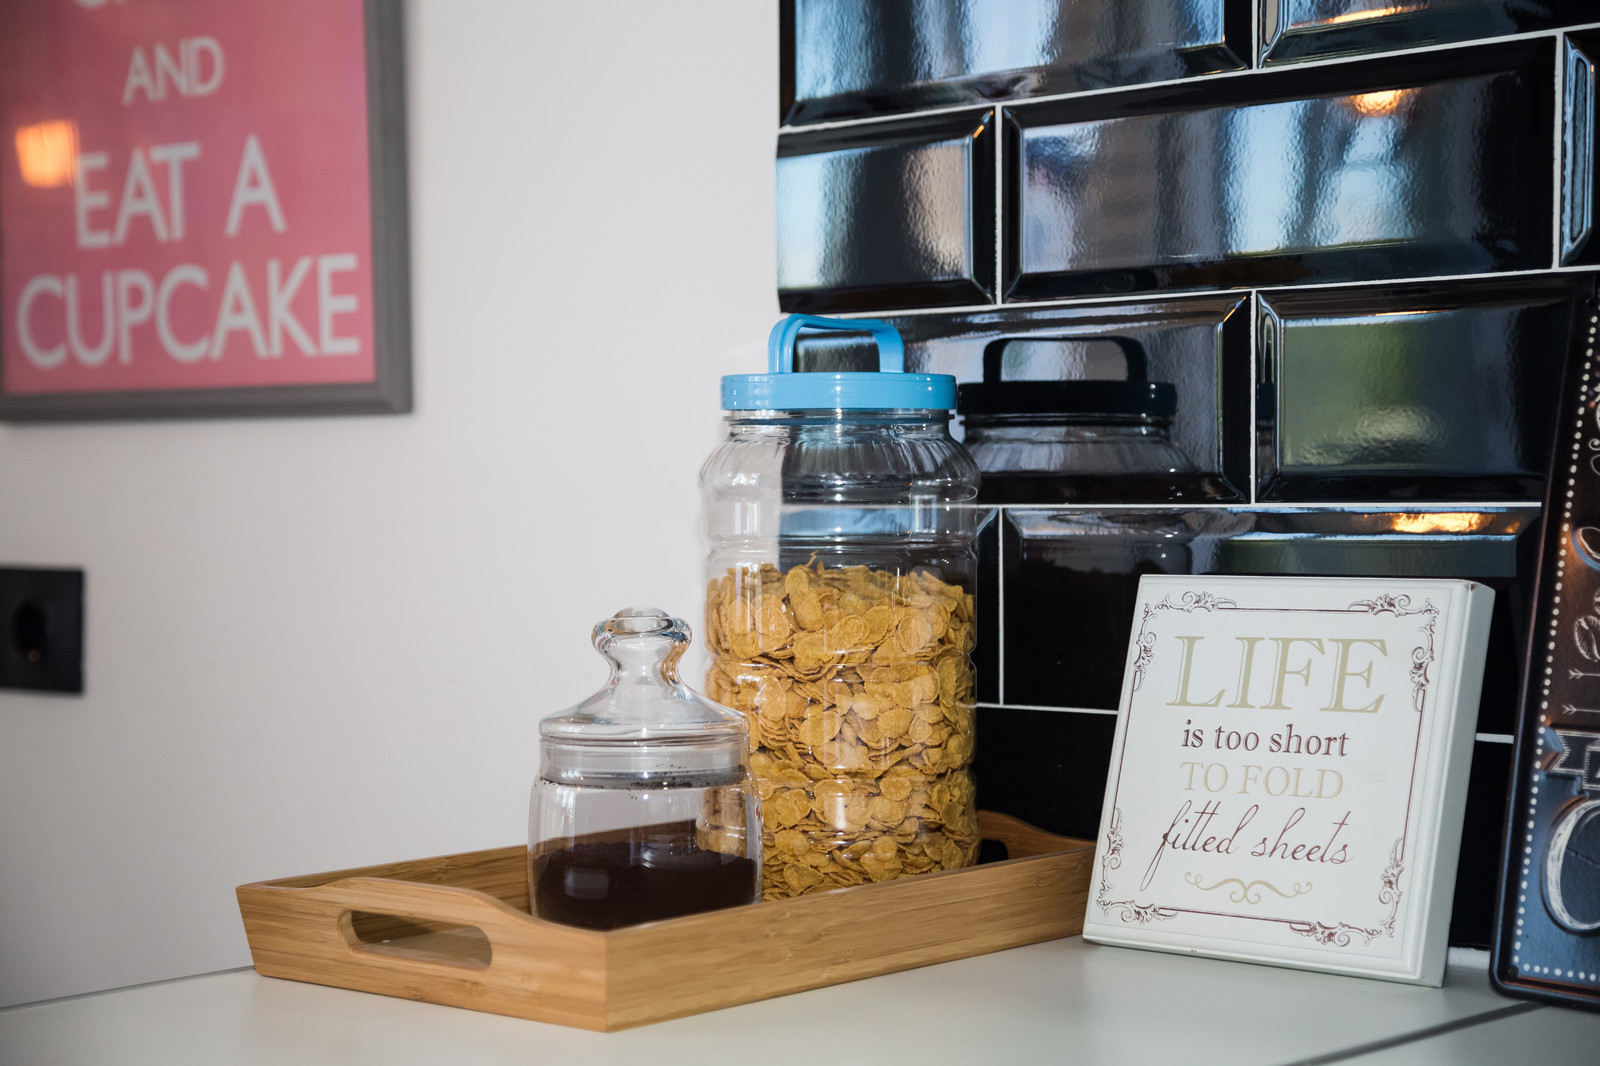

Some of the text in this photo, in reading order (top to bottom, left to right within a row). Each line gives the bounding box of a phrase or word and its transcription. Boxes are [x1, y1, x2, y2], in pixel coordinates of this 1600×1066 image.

[123, 36, 225, 104] AND
[76, 134, 286, 248] EAT A
[16, 253, 361, 368] CUPCAKE
[1166, 636, 1388, 714] LIFE
[1181, 719, 1350, 757] is too short
[1180, 761, 1344, 799] TO FOLD
[1140, 799, 1354, 892] fitted sheets
